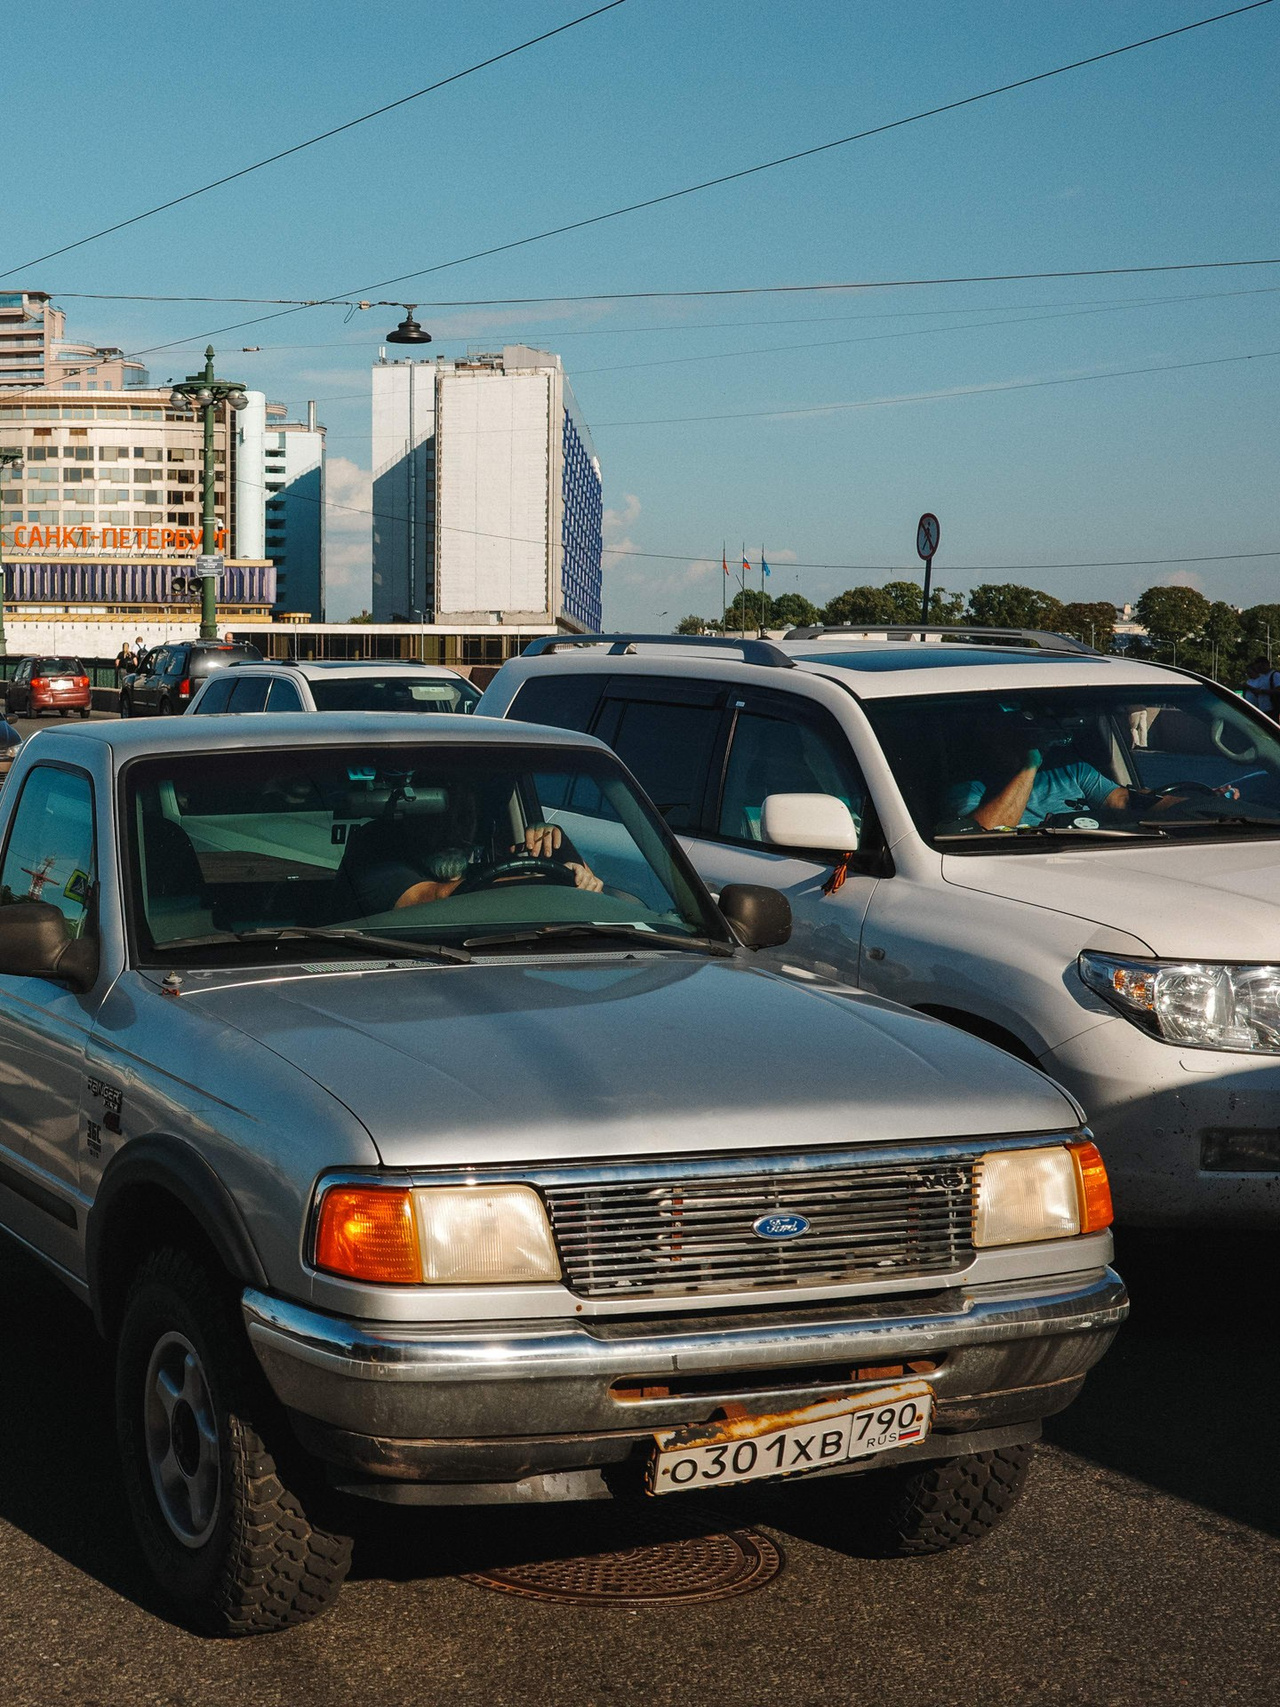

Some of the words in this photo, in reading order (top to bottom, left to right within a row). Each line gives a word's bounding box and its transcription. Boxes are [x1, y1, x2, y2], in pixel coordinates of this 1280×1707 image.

[766, 1218, 798, 1233] Ford
[856, 1402, 918, 1442] 790
[866, 1432, 898, 1449] RUS
